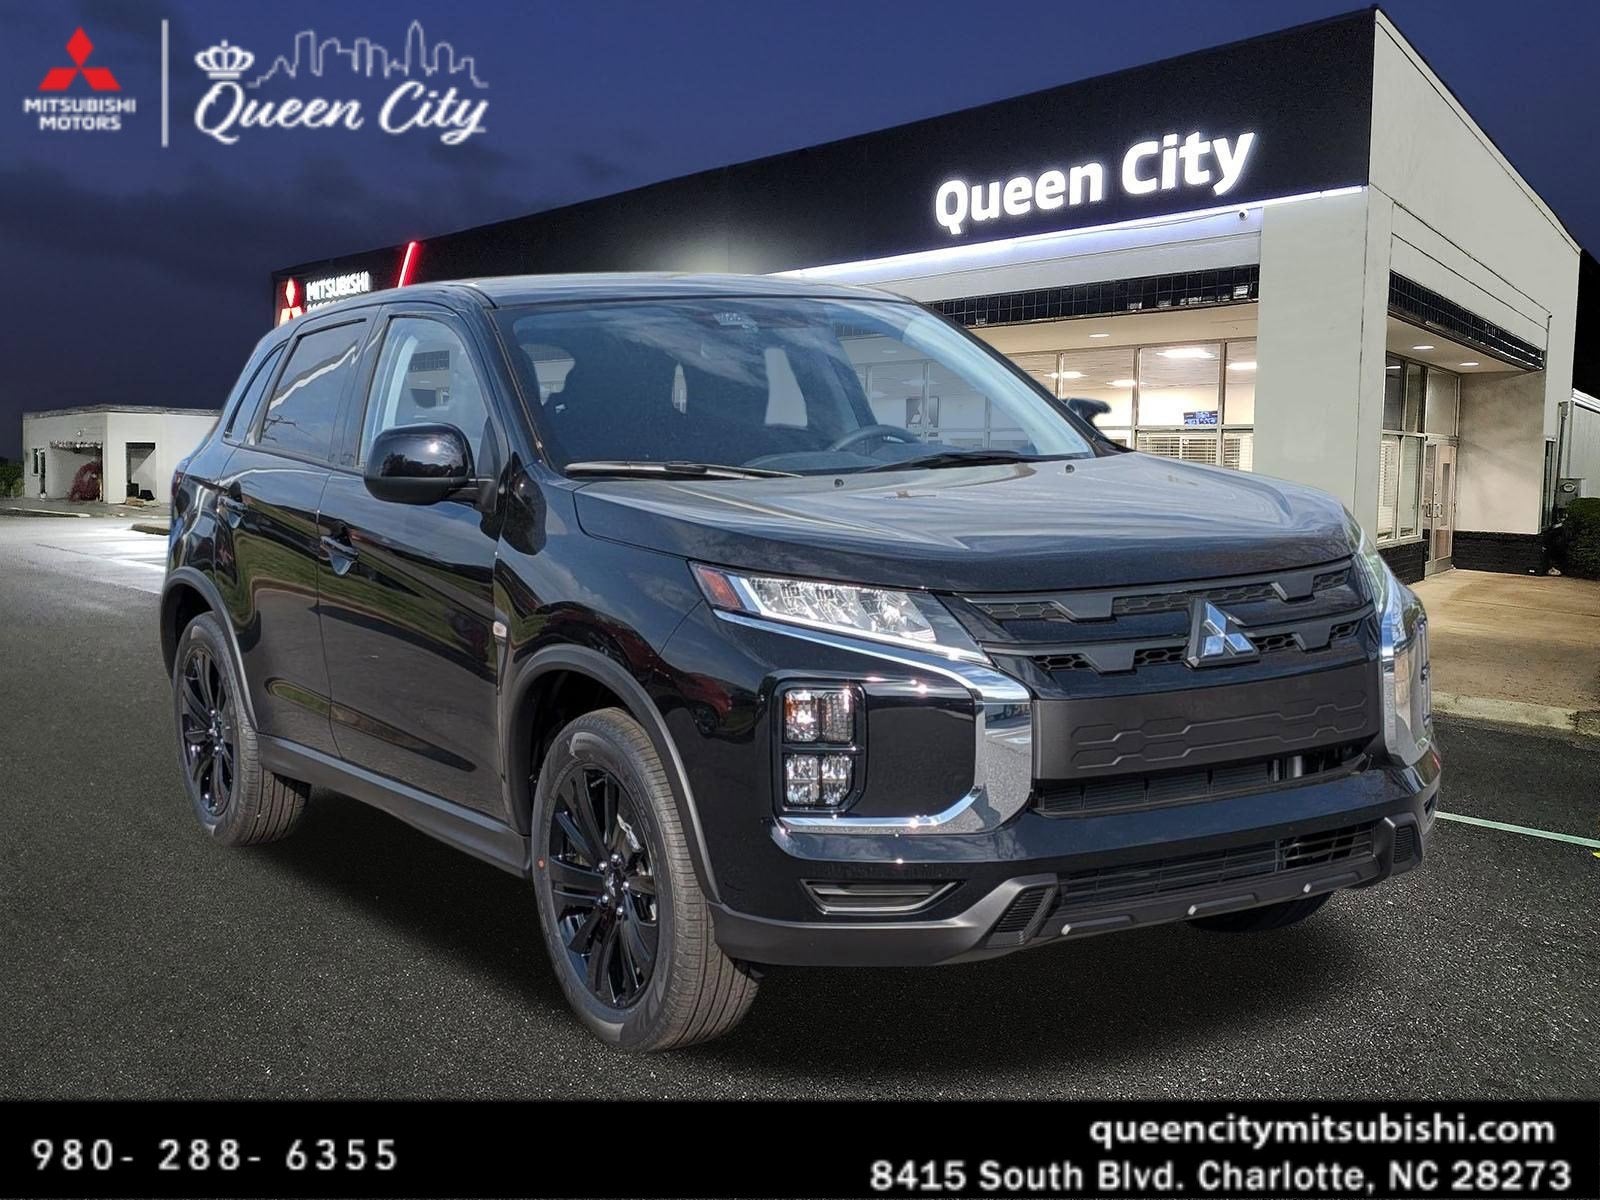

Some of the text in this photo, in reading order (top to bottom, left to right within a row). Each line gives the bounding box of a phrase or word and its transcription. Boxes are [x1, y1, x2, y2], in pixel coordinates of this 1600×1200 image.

[935, 131, 1256, 235] Queen City
[305, 270, 370, 302] MITSUBISHI
